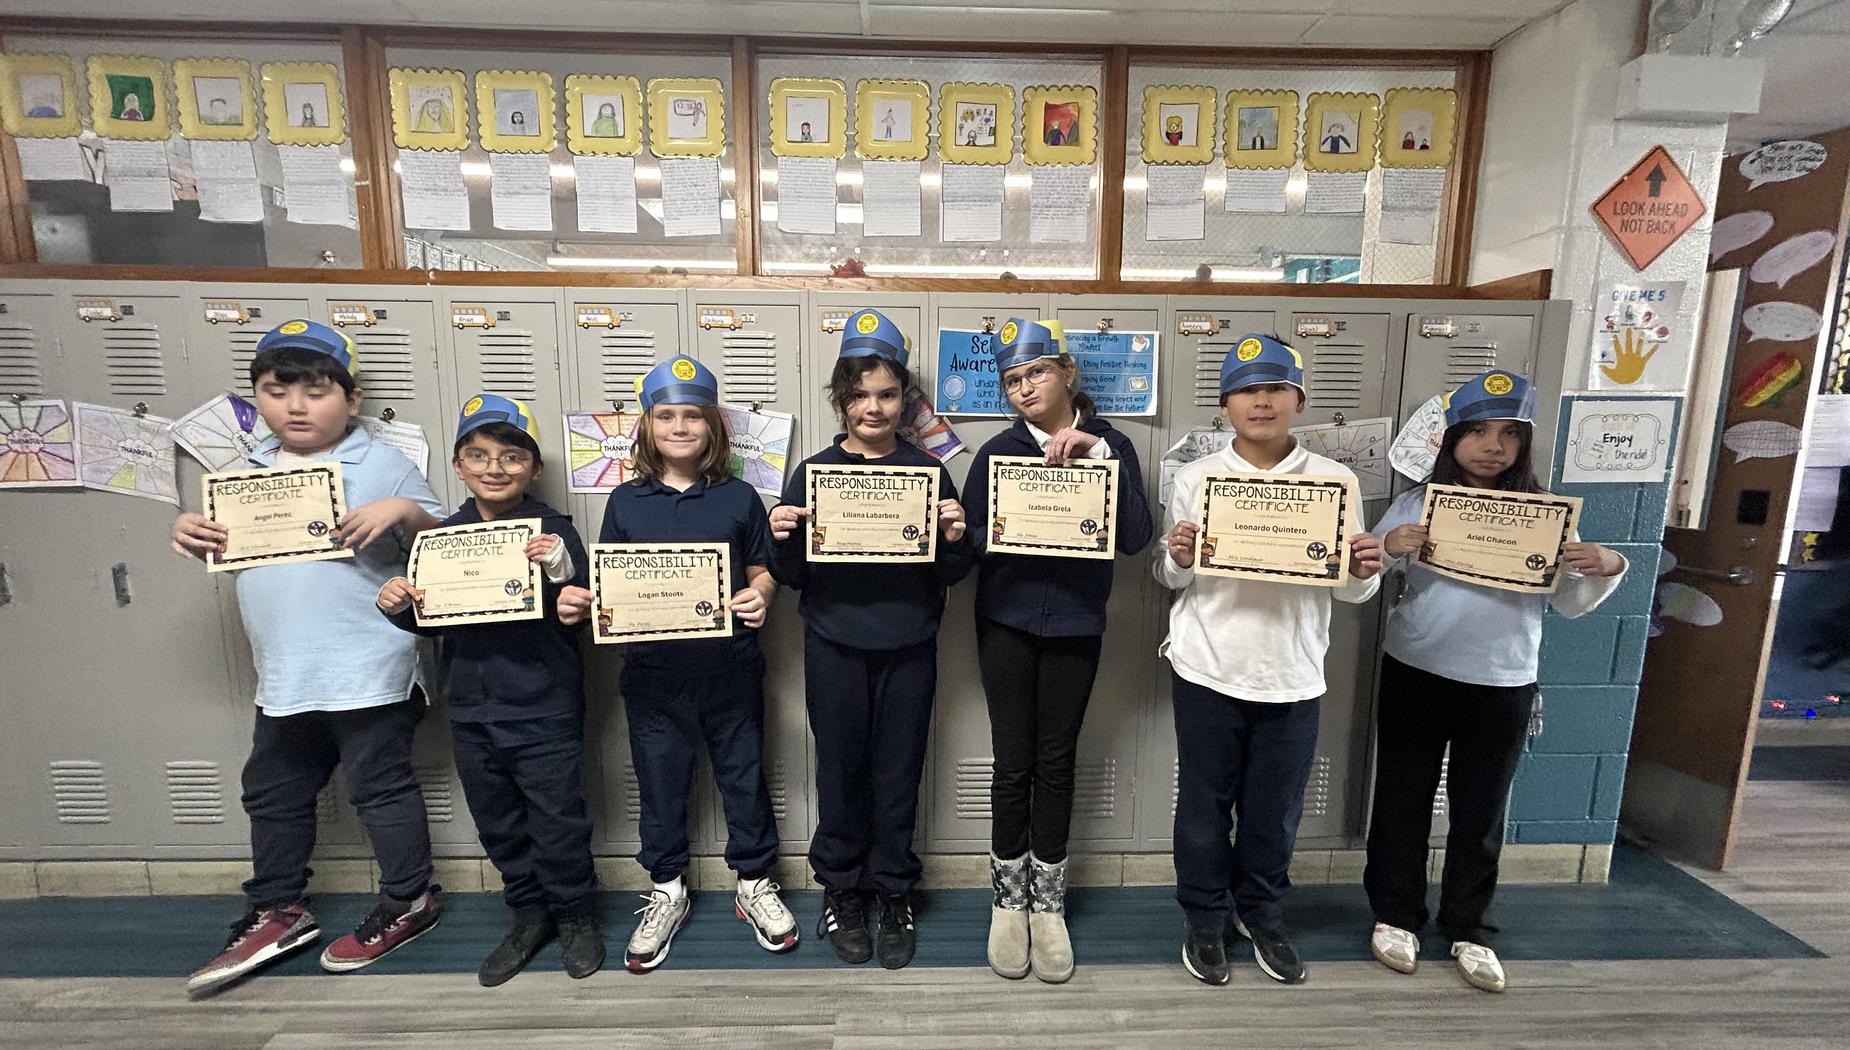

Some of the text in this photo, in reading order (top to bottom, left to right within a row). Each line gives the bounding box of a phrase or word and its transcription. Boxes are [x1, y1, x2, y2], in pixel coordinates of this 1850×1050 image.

[1613, 201, 1689, 217] LOOK AHEAD
[1620, 219, 1677, 234] NOT BACK
[1638, 290, 1656, 301] ME
[1658, 290, 1666, 301] 5
[971, 335, 995, 354] Sel
[950, 353, 999, 373] Aware
[1083, 360, 1099, 368] Using
[730, 441, 760, 453] THANKFUL
[1603, 433, 1633, 448] Enjoy
[121, 446, 153, 458] THANKFUL
[1615, 449, 1629, 460] the
[1000, 468, 1103, 484] RESPONSIBILITY
[216, 474, 325, 496] RESPONSIBILITY
[820, 477, 925, 491] RESPONSIBILITY
[1019, 482, 1081, 494] CERTIFICATE
[240, 489, 304, 505] CERTIFICATE
[839, 490, 903, 501] CERTIFICATE
[1213, 484, 1337, 503] RESPONSIBILITY
[1028, 503, 1052, 512] Izabela
[1235, 499, 1310, 514] CERTIFICATE
[1438, 497, 1564, 521] RESPONSIBILITY
[254, 513, 273, 522] Angel
[842, 511, 865, 519] Liliana
[1459, 512, 1535, 529] CERTIFICATE
[1234, 523, 1307, 535] Leonardo Quintero
[423, 531, 525, 552] RESPONSIBILITY
[1466, 533, 1517, 546] Ariel Chacon
[441, 546, 504, 560] CERTIFICATE
[603, 555, 714, 569] RESPONSIBILITY
[625, 569, 694, 580] CERTIFICATE
